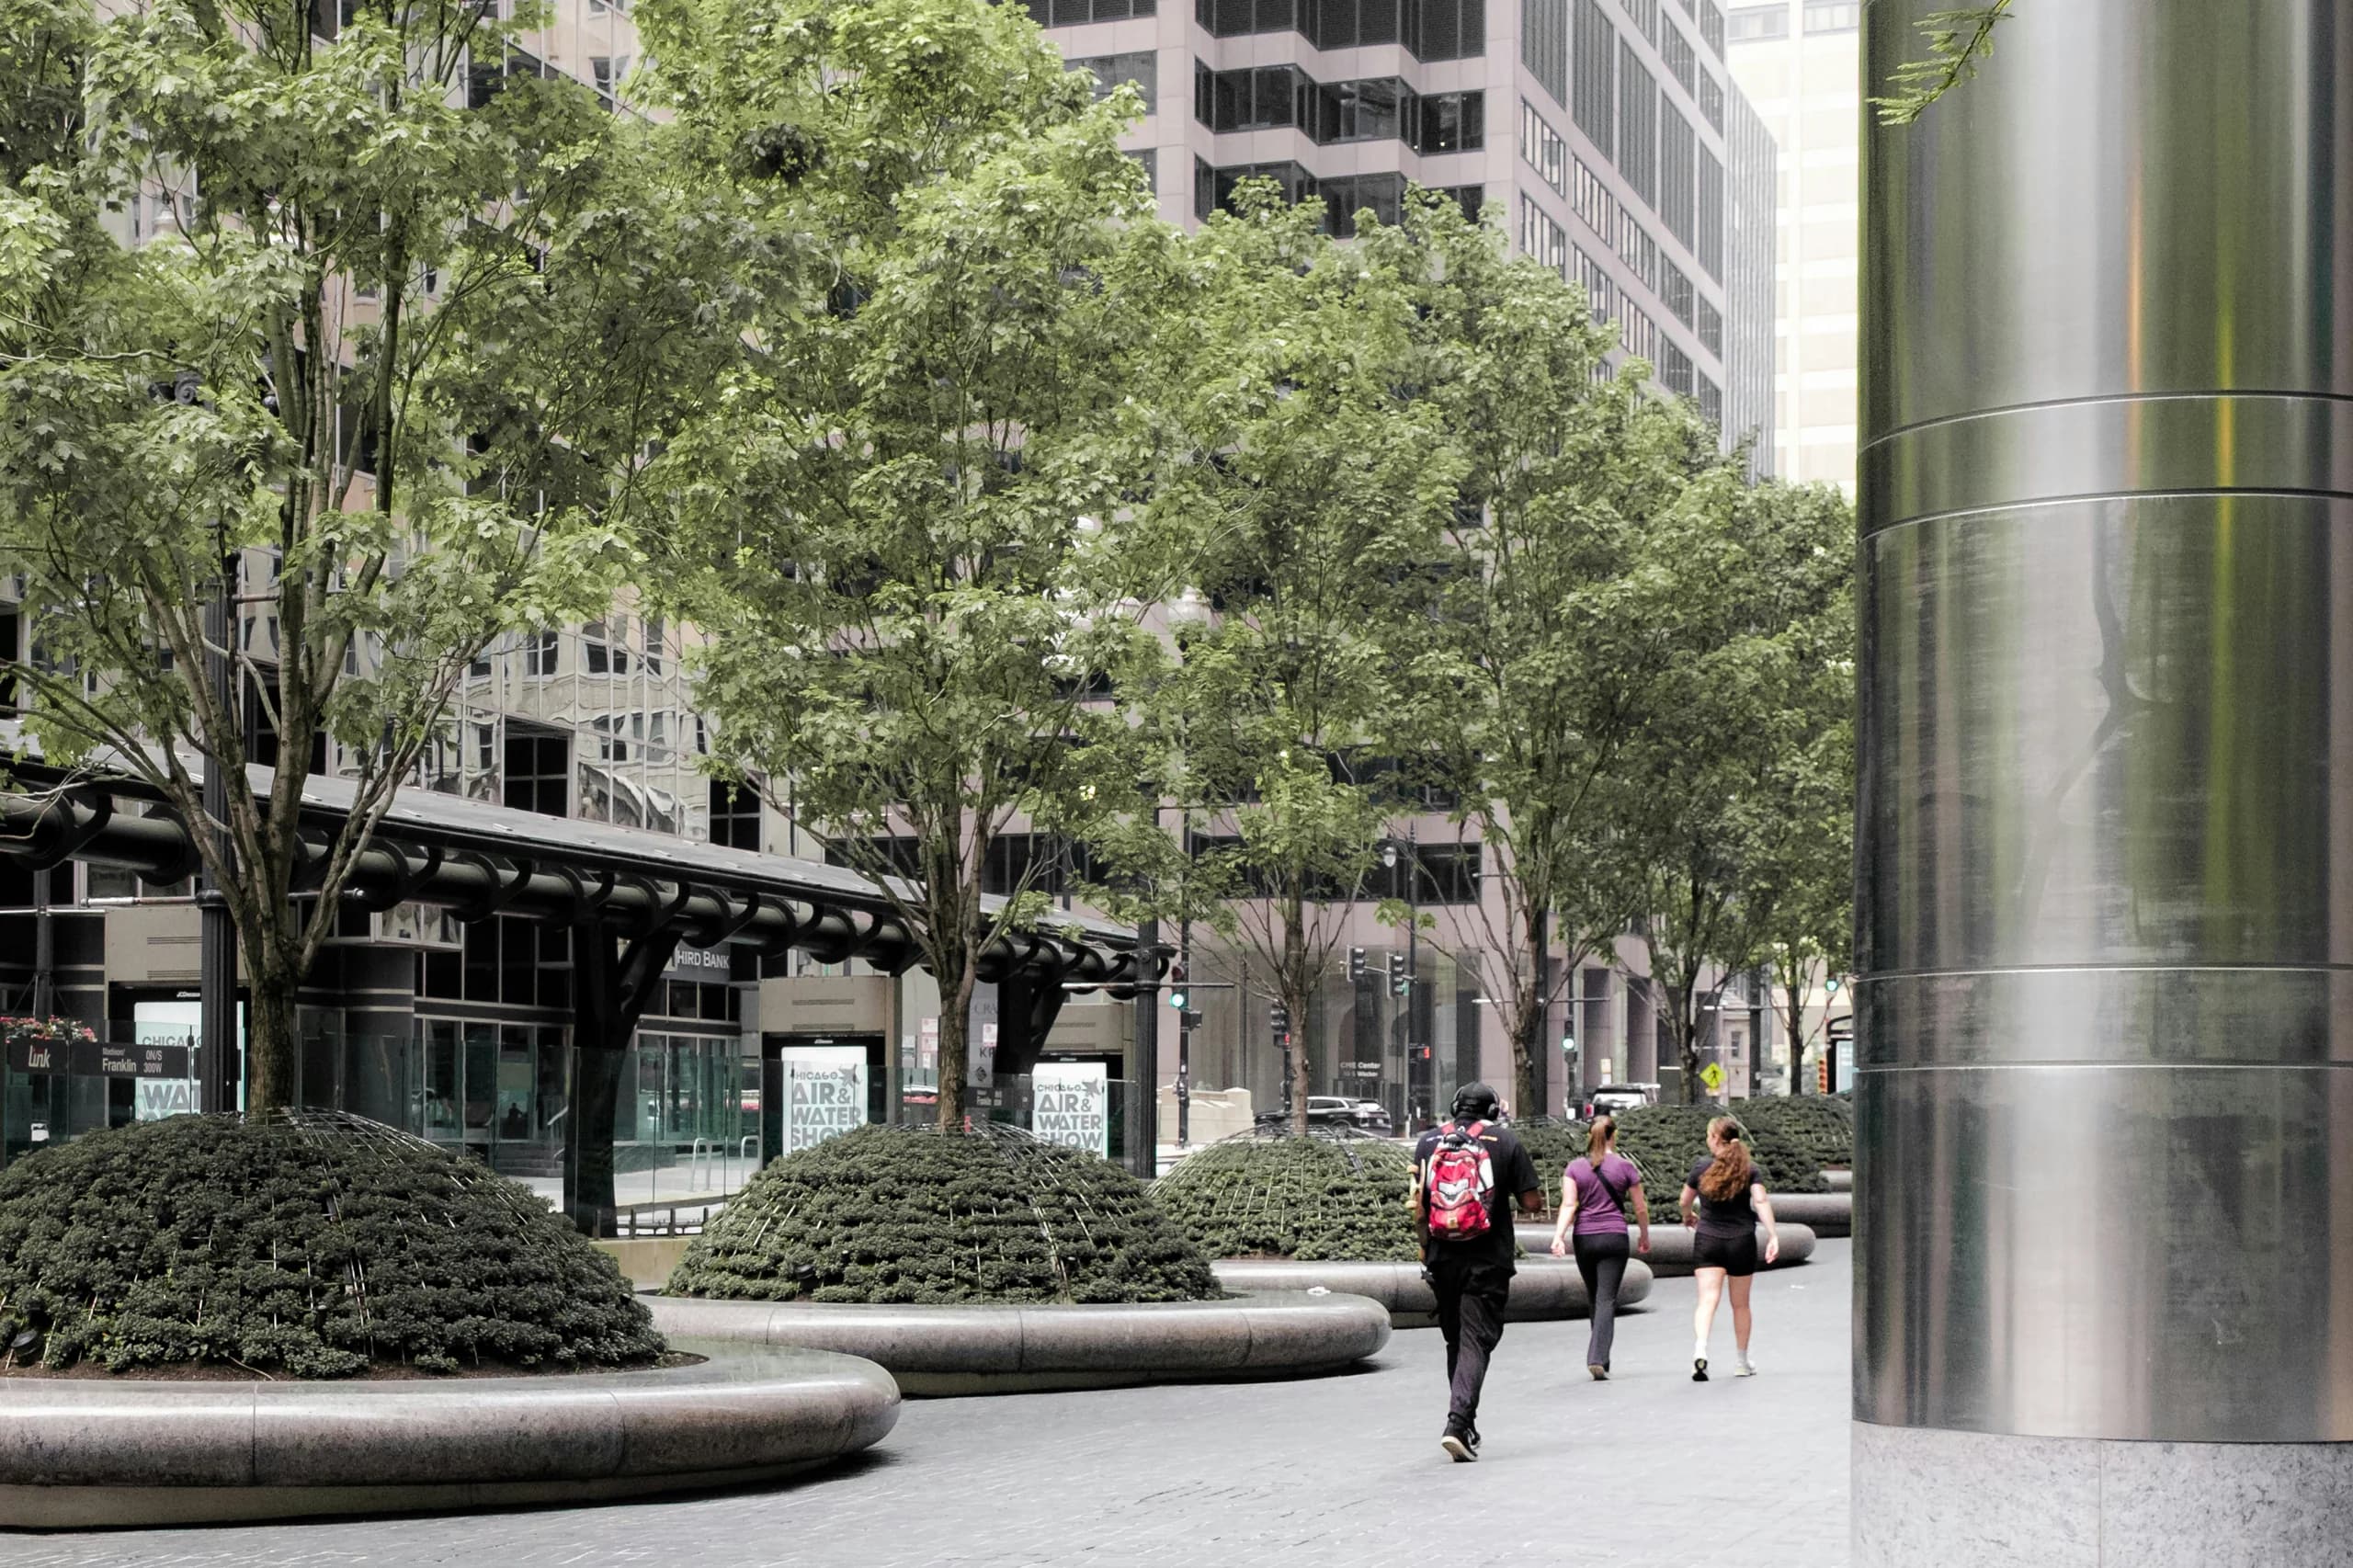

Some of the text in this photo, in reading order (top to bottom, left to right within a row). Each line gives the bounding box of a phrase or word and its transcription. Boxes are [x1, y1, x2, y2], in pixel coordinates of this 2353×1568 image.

[676, 949, 701, 966] HIRD
[102, 1058, 137, 1073] Franklin
[790, 1071, 838, 1080] HICAGO
[143, 1085, 201, 1110] WAT
[792, 1083, 851, 1105] AIR &
[1038, 1094, 1092, 1113] AIR &
[791, 1107, 861, 1126] WATER
[1038, 1114, 1101, 1131] WATER
